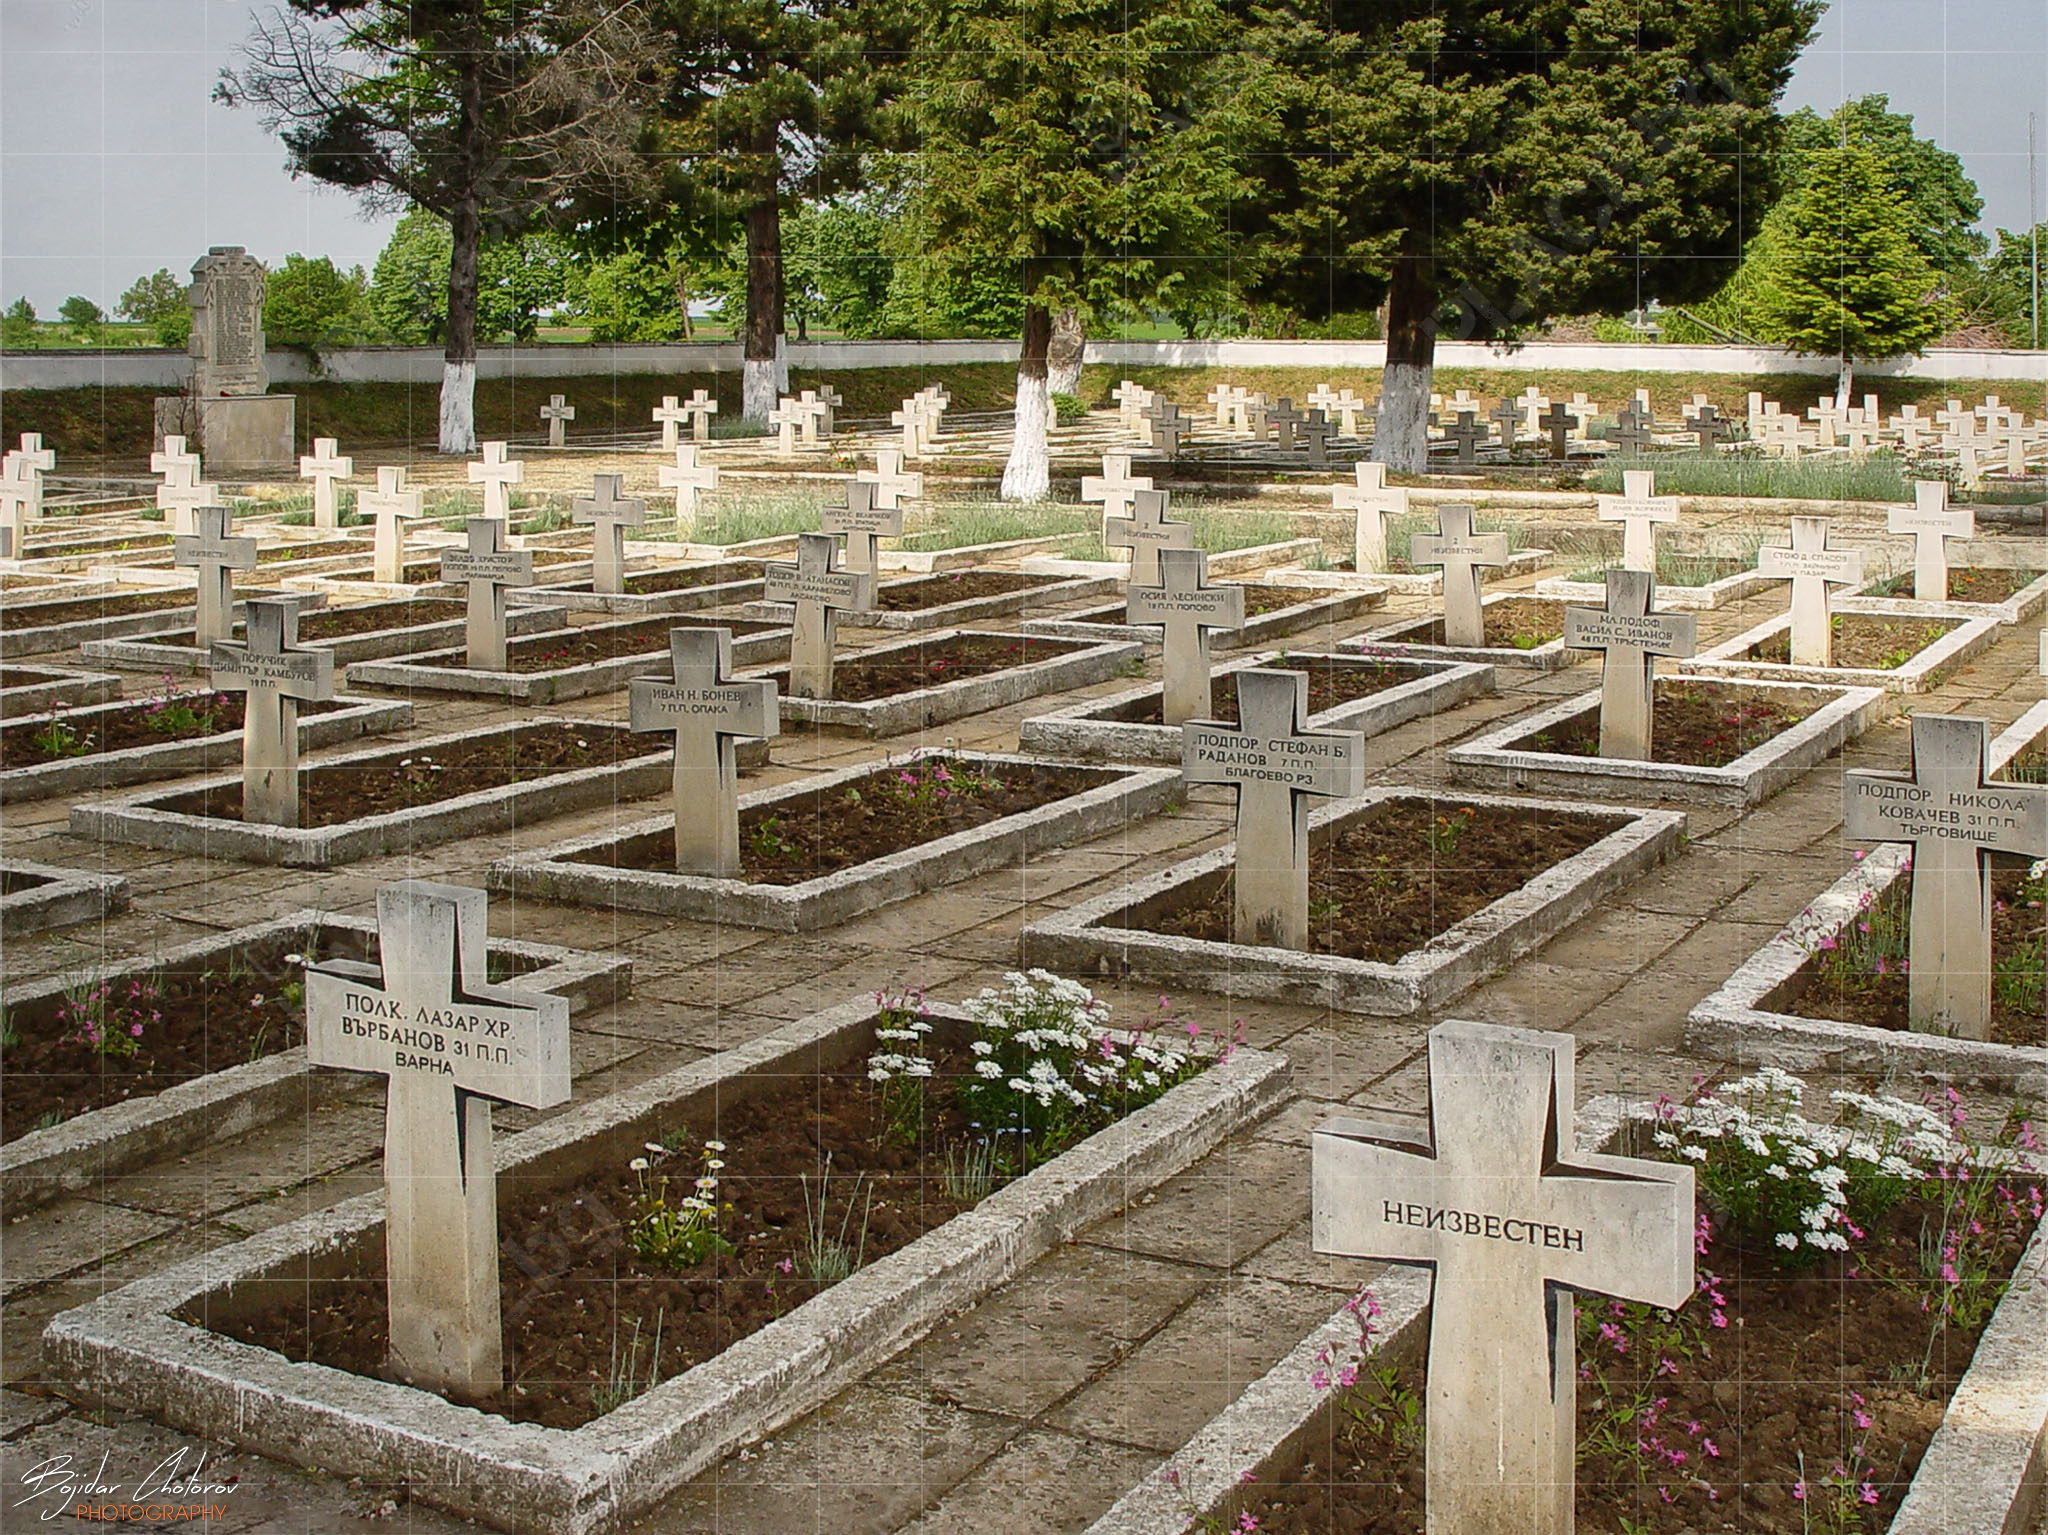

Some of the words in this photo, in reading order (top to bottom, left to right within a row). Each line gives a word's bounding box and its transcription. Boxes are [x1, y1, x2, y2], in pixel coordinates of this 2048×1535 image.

[1575, 624, 1612, 635] ВАСИЛ
[1628, 628, 1673, 641] ИВАНОВ
[242, 652, 288, 667] ПОРУЧИК
[213, 662, 259, 676] ДИМИТЪР
[264, 668, 316, 682] КАМБУРОВ
[652, 688, 685, 700] ИВАН
[701, 690, 742, 701] БОНЕВ
[660, 703, 667, 712] 7
[691, 704, 729, 714] ОПАКА
[1198, 749, 1268, 766] РАДАНОВ
[1281, 758, 1288, 768] 7
[1268, 739, 1329, 756] СТЕФАН
[1333, 746, 1347, 759] Б.
[1224, 767, 1294, 783] БЛАГОЕВО
[1858, 783, 1934, 803] ПОДПОР.
[1949, 792, 2026, 812] НИКОЛА
[1878, 804, 1961, 825] КОВАЧЕВ
[1967, 814, 1982, 826] 31
[345, 992, 409, 1021] ПОЛК.
[415, 1006, 480, 1034] ЛАЗАР
[341, 1016, 446, 1053] ВЪРБАНОВ
[453, 1040, 470, 1058] 31
[395, 1051, 456, 1077] ВАРНА
[1383, 1199, 1585, 1253] НЕИЗВЕСТЕН
